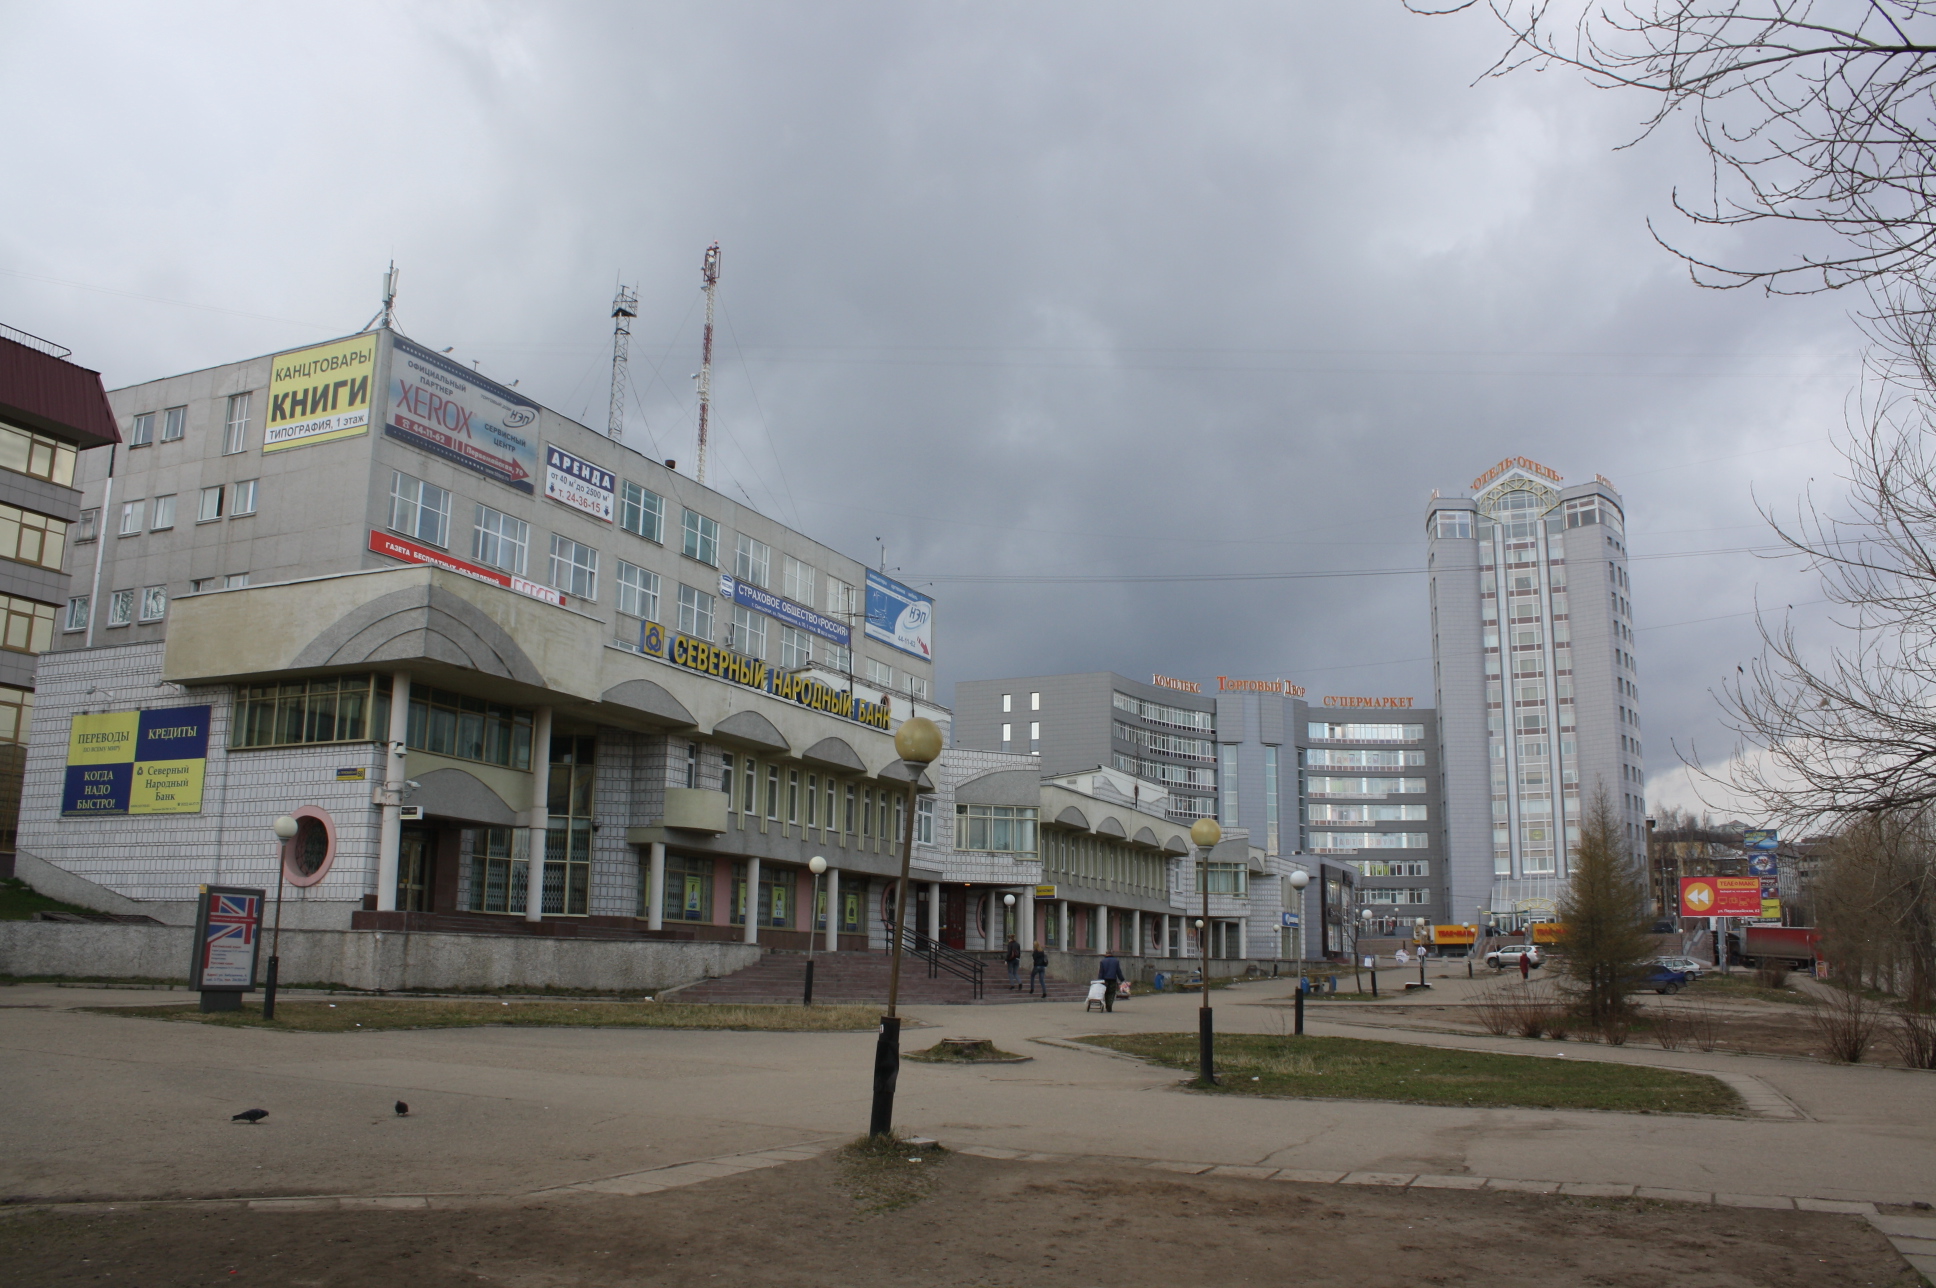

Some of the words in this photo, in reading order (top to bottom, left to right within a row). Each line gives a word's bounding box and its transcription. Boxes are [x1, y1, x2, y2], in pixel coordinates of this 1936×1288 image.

[275, 348, 372, 382] КАНЦТОВАРЫ
[407, 360, 467, 393] ОФИЦИАЛЬНЫЙ
[420, 376, 454, 397] ПАРТНЕР
[271, 375, 369, 422] КНИГИ
[396, 378, 473, 439] XEROX
[270, 419, 334, 440] ТИПОГРАФИЯ,
[336, 417, 340, 428] 1
[344, 415, 365, 426] этаж
[510, 409, 531, 426] НЭП
[413, 424, 447, 444] 44-11-62
[484, 423, 527, 448] СЕРВИСНЫЙ
[493, 437, 517, 453] ЦЕНТР
[516, 467, 525, 477] 70
[551, 452, 612, 490] АРЕНДА
[1473, 457, 1513, 490] ОТЕЛЬ
[1517, 456, 1561, 482] ОТЕЛЬ
[551, 472, 559, 481] от
[559, 474, 568, 485] 40
[576, 484, 585, 493] до
[586, 486, 602, 499] 2500
[566, 490, 602, 514] 24-36-15
[385, 541, 412, 557] ГАЗЕТА
[738, 584, 781, 610] СТРАХОВОЕ
[781, 601, 819, 626] ОБЩЕСТВО
[818, 617, 849, 637] «РОССИЯ»
[909, 606, 927, 624] НЭП
[671, 635, 766, 689] СЕВЕРНЫЙ
[769, 668, 853, 718] НАРОДНЫЙ
[856, 697, 891, 731] БАНК
[1153, 674, 1203, 694] КОМПЛЕКС
[1323, 695, 1415, 708] СУПЕРМАРКЕТ
[78, 730, 130, 745] ПЕРЕВОДЫ
[147, 725, 198, 741] КРЕДИТЫ
[84, 770, 114, 782] КОГДА
[147, 764, 190, 778] Северный
[84, 785, 111, 796] НАДО
[145, 778, 190, 792] Народный
[77, 798, 115, 810] БЫСТРО!
[155, 792, 176, 802] Банк
